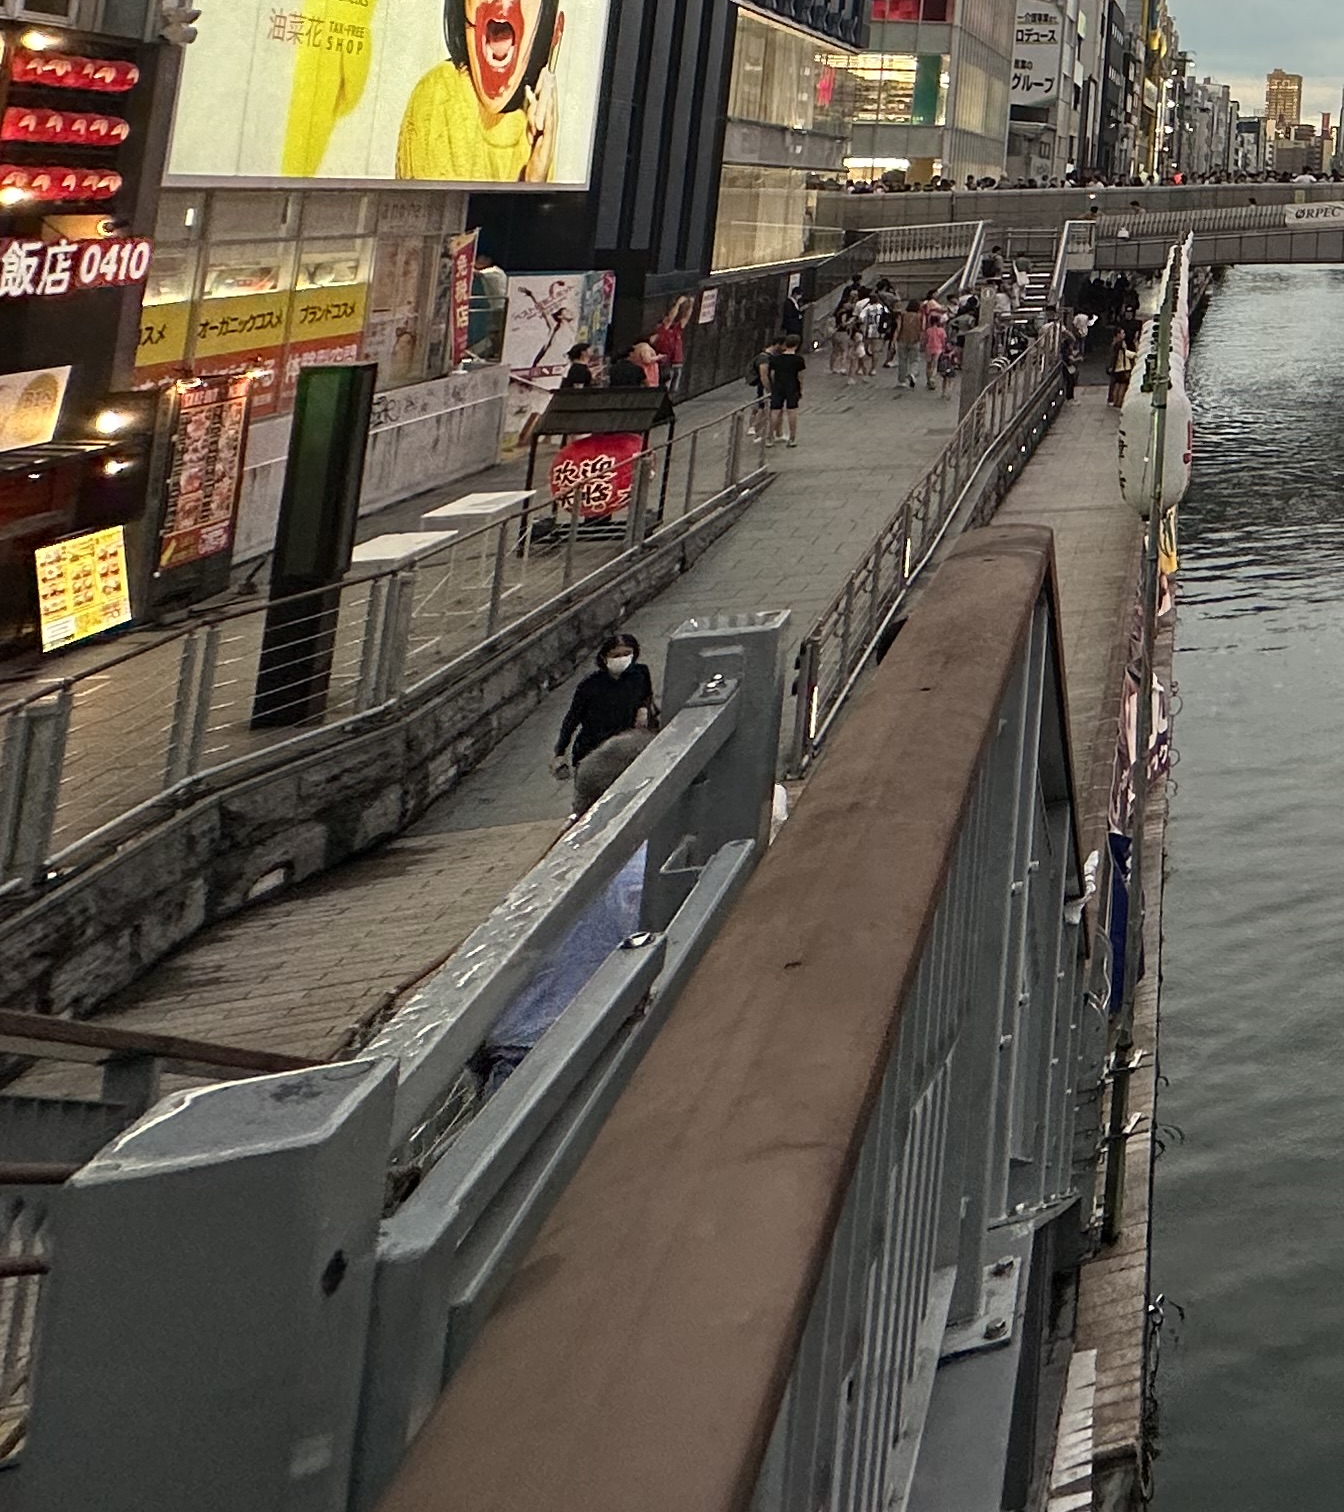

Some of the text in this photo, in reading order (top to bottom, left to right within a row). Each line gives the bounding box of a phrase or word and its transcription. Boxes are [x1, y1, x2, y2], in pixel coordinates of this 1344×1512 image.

[267, 7, 326, 48] 油菜花
[326, 35, 364, 56] SHOP
[0, 239, 151, 296] 飯店 0410
